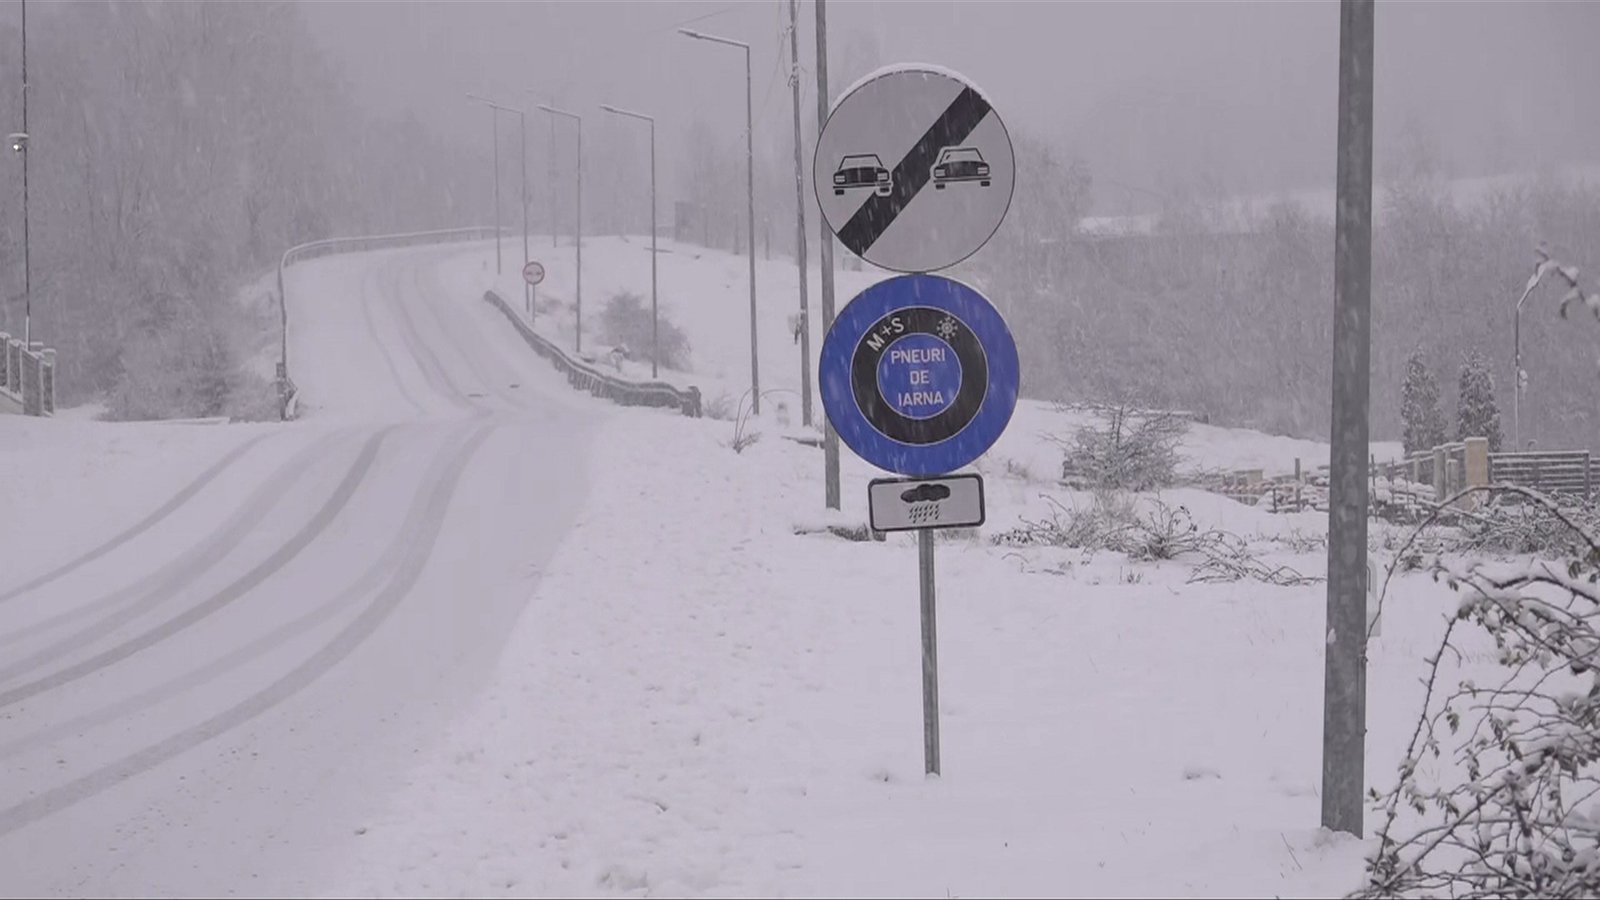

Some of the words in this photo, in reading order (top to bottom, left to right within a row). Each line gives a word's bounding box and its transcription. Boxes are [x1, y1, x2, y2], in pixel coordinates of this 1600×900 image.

[866, 317, 905, 352] M+S
[891, 347, 946, 364] PNEURI
[910, 370, 930, 385] DE
[898, 391, 944, 407] IARNA
